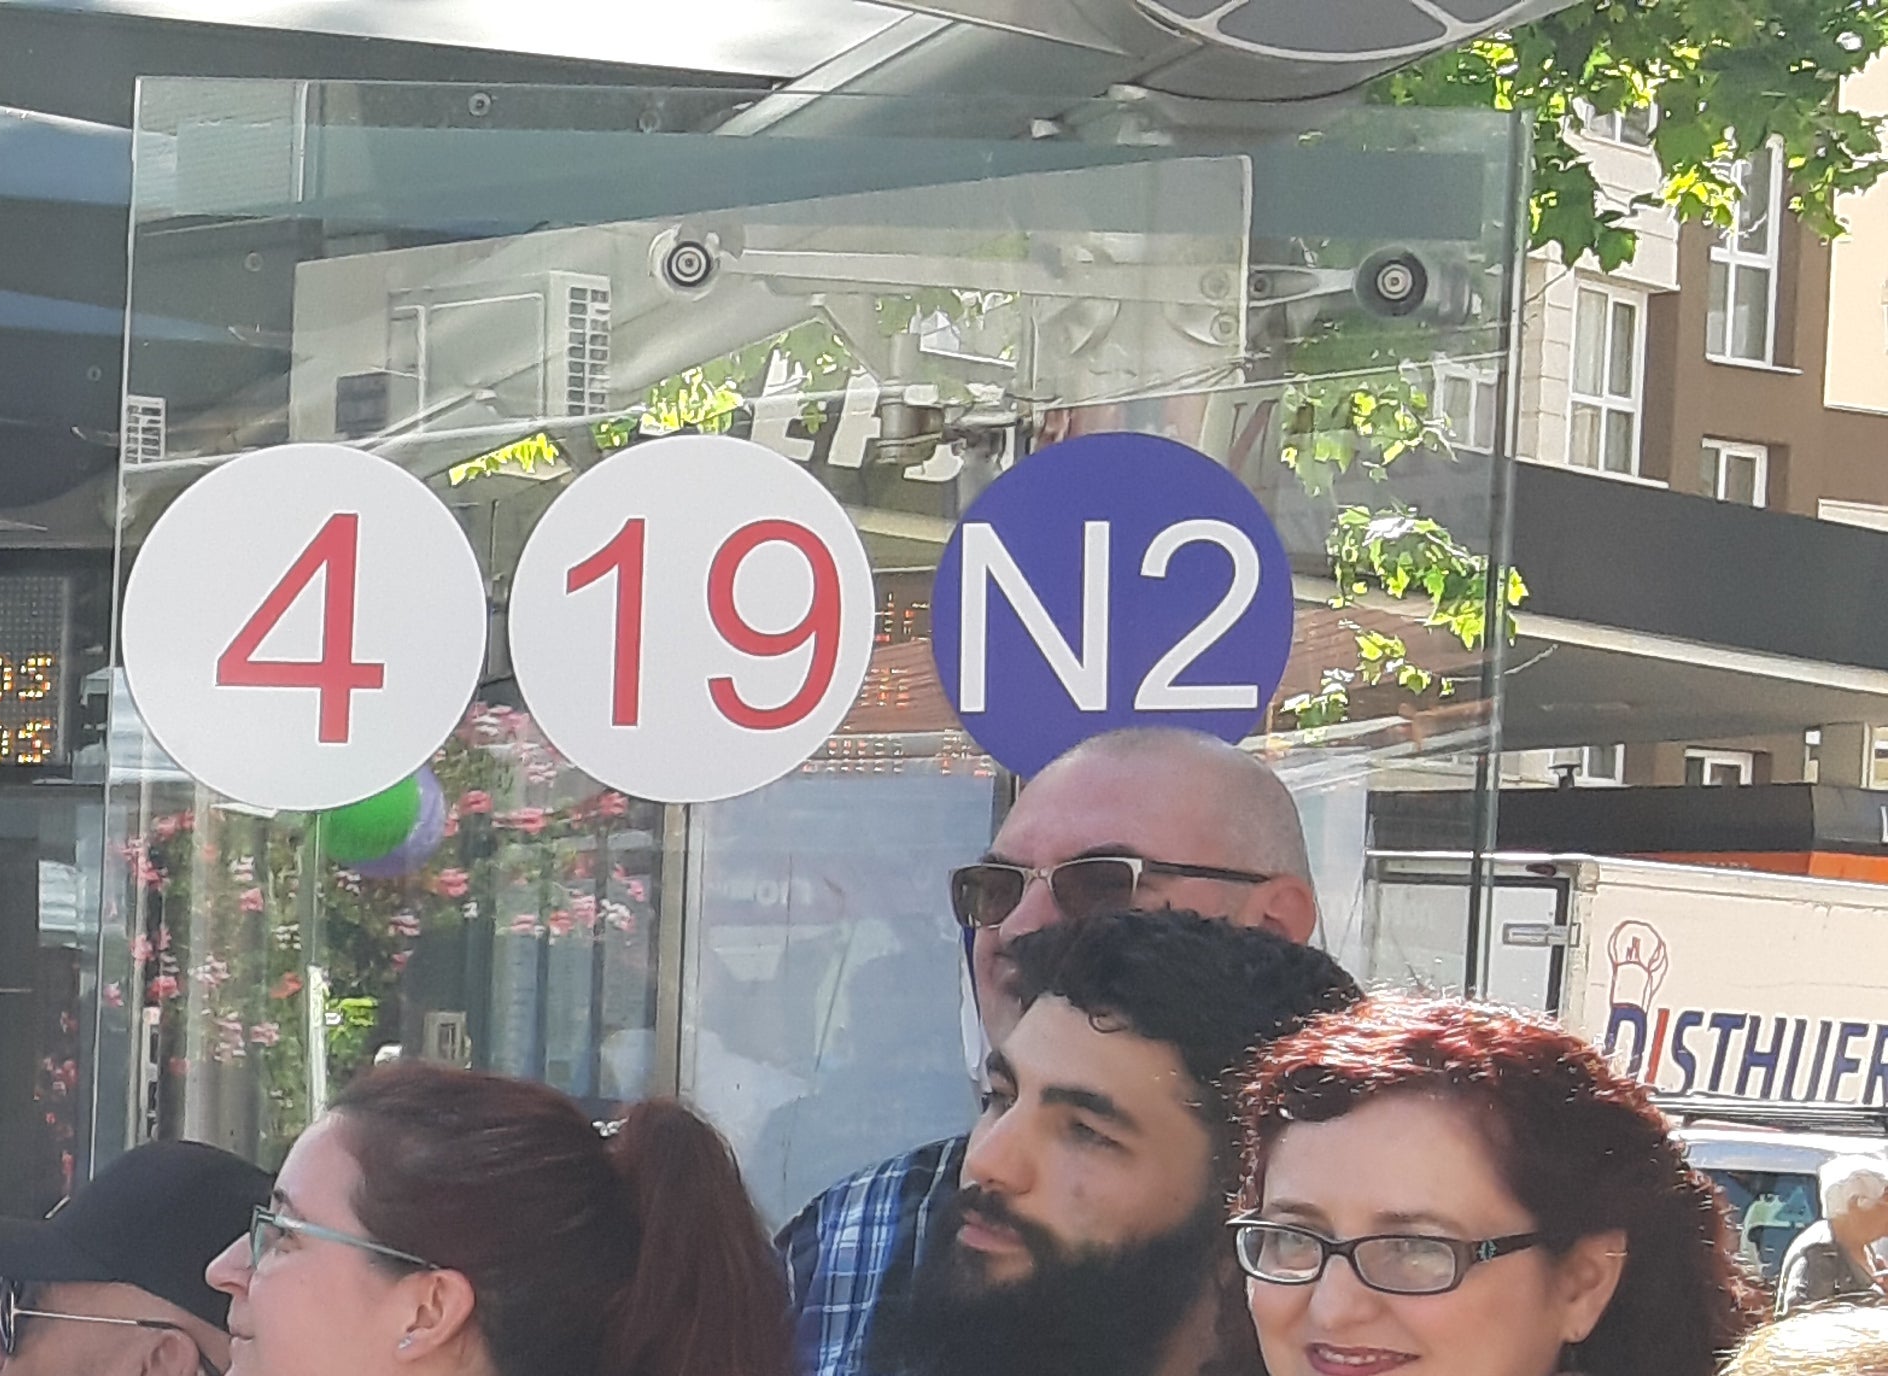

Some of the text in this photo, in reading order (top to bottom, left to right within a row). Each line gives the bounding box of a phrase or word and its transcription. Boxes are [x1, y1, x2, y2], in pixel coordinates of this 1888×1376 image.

[216, 513, 385, 744] 4
[564, 518, 843, 731] 19
[960, 520, 1260, 713] N2
